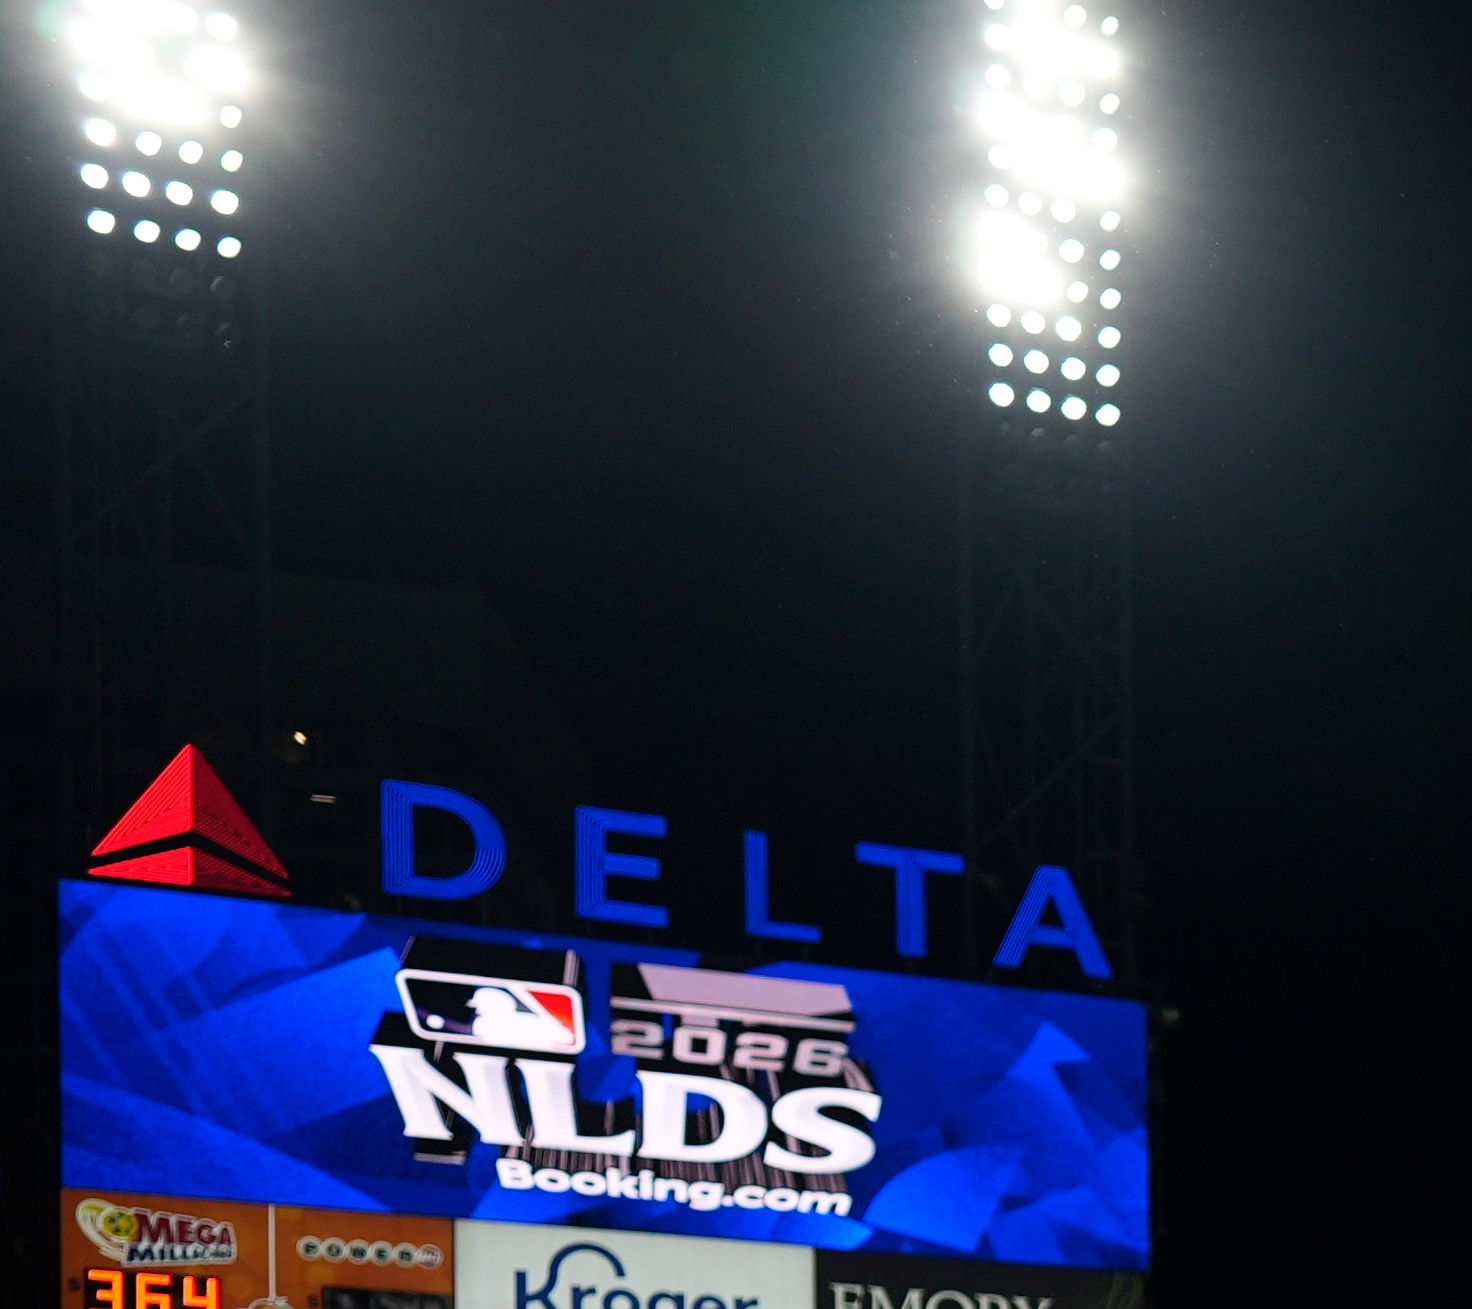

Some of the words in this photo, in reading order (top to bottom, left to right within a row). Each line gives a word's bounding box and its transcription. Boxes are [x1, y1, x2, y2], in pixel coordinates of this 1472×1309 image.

[381, 778, 1113, 979] DELTA
[611, 1017, 849, 1077] 2026
[368, 1043, 883, 1176] NLDS
[496, 1156, 854, 1219] Booking.com
[137, 1212, 232, 1245] MEGA
